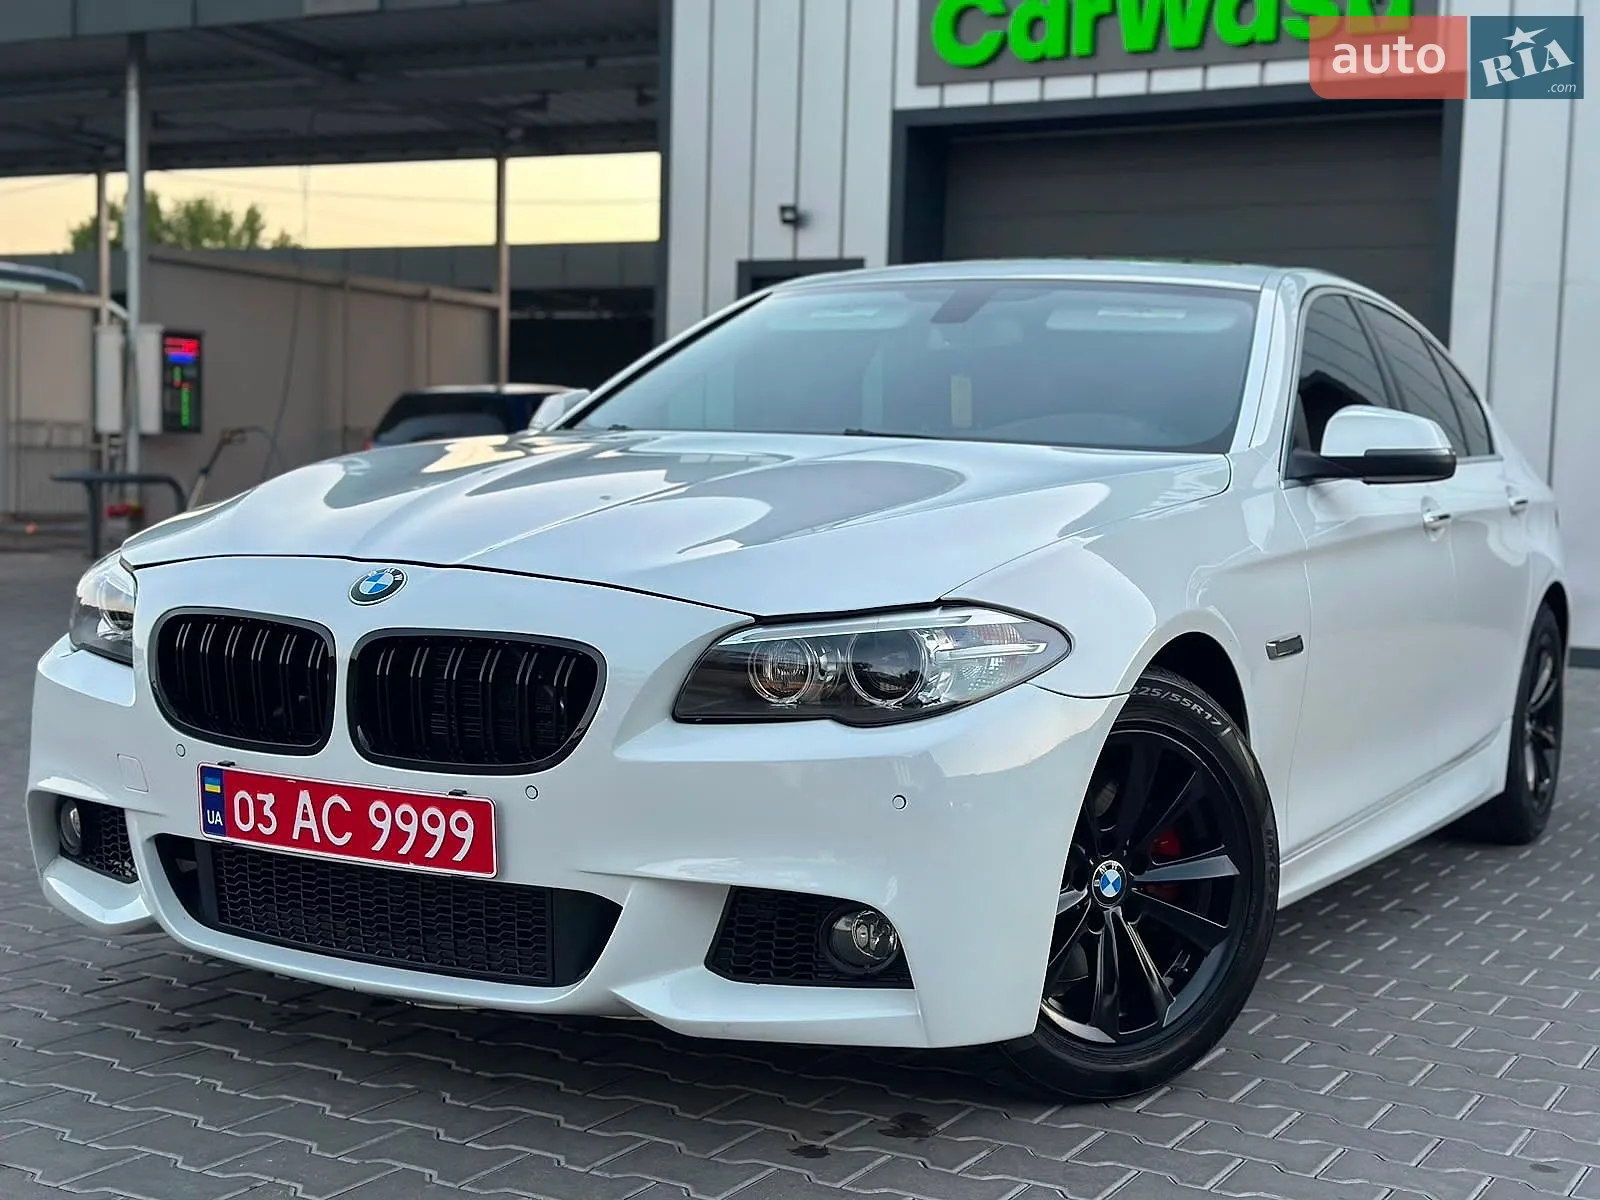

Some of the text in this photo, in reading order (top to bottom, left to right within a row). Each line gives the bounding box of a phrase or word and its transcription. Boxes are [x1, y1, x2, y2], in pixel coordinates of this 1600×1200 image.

[206, 809, 224, 826] UA
[233, 789, 475, 861] 03 AC 9999
